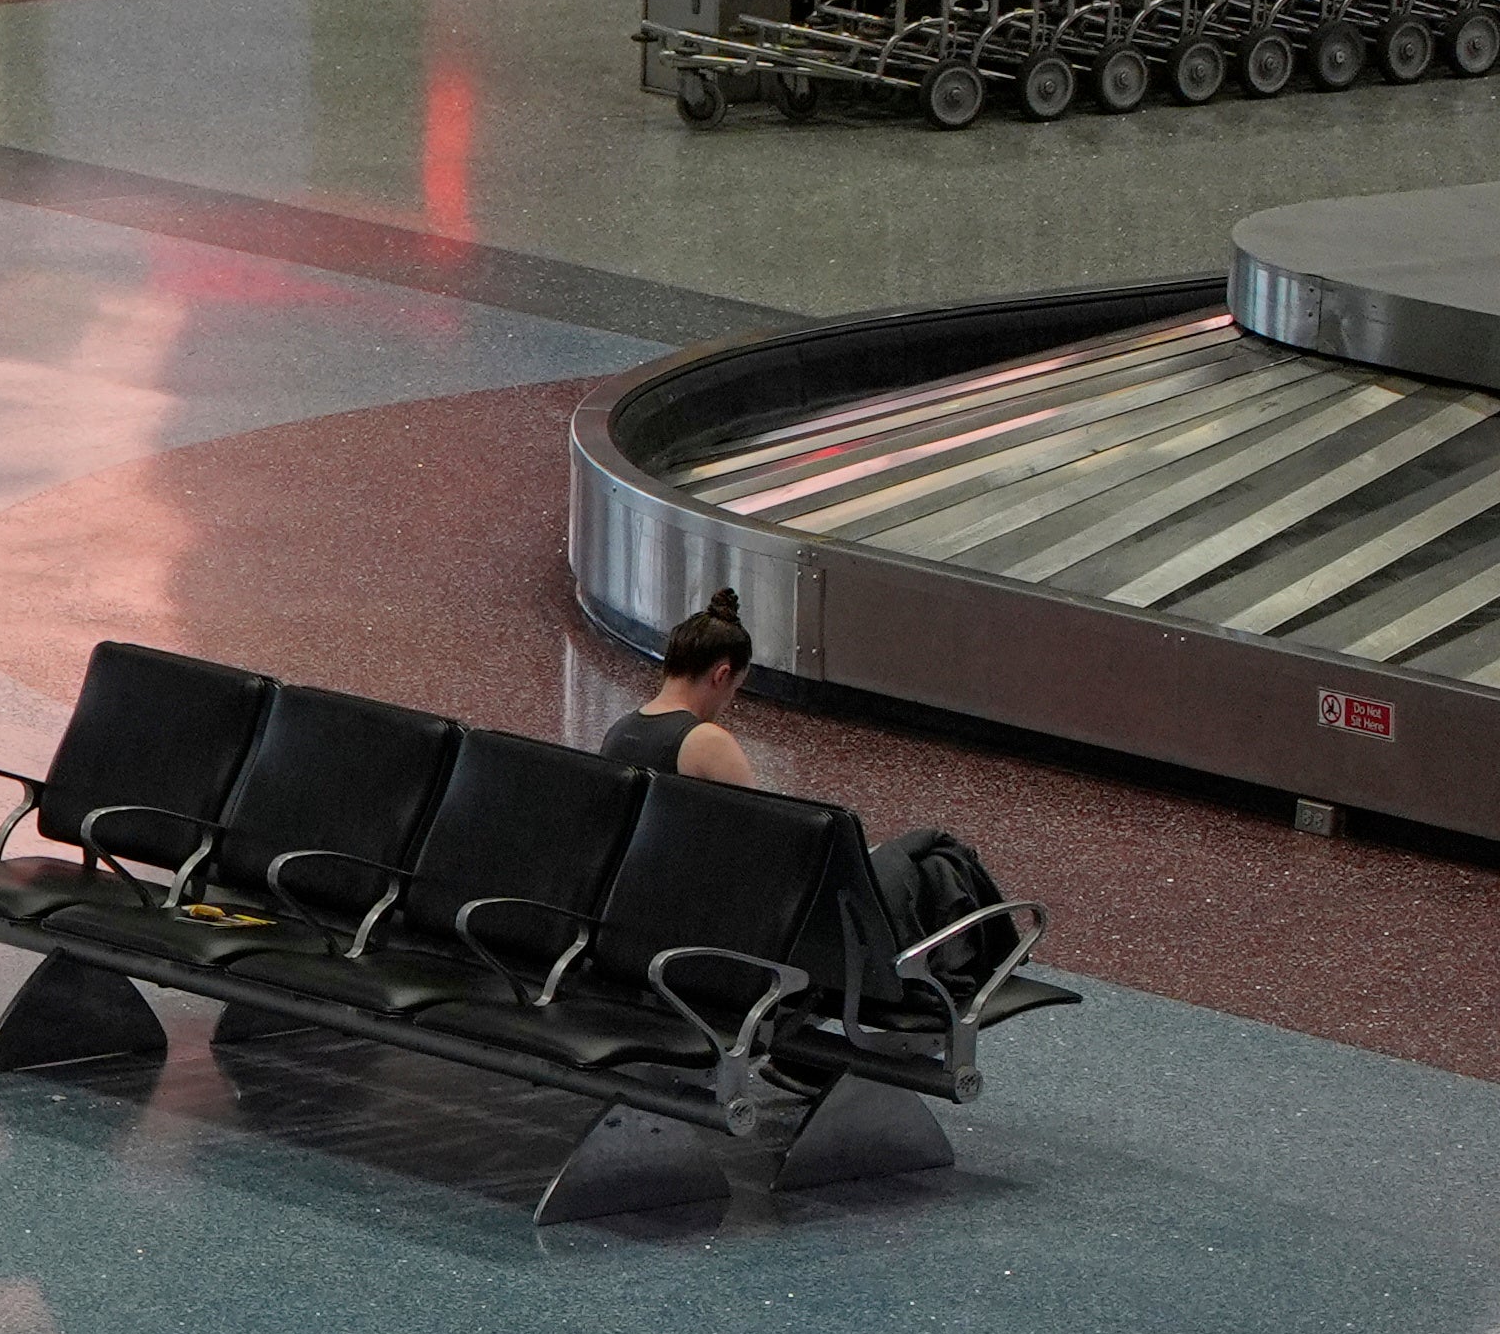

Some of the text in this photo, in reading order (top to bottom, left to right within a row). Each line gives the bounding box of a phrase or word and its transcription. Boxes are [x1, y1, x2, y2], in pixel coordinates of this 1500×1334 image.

[1352, 701, 1382, 719] Do Not
[1363, 717, 1385, 733] Here
